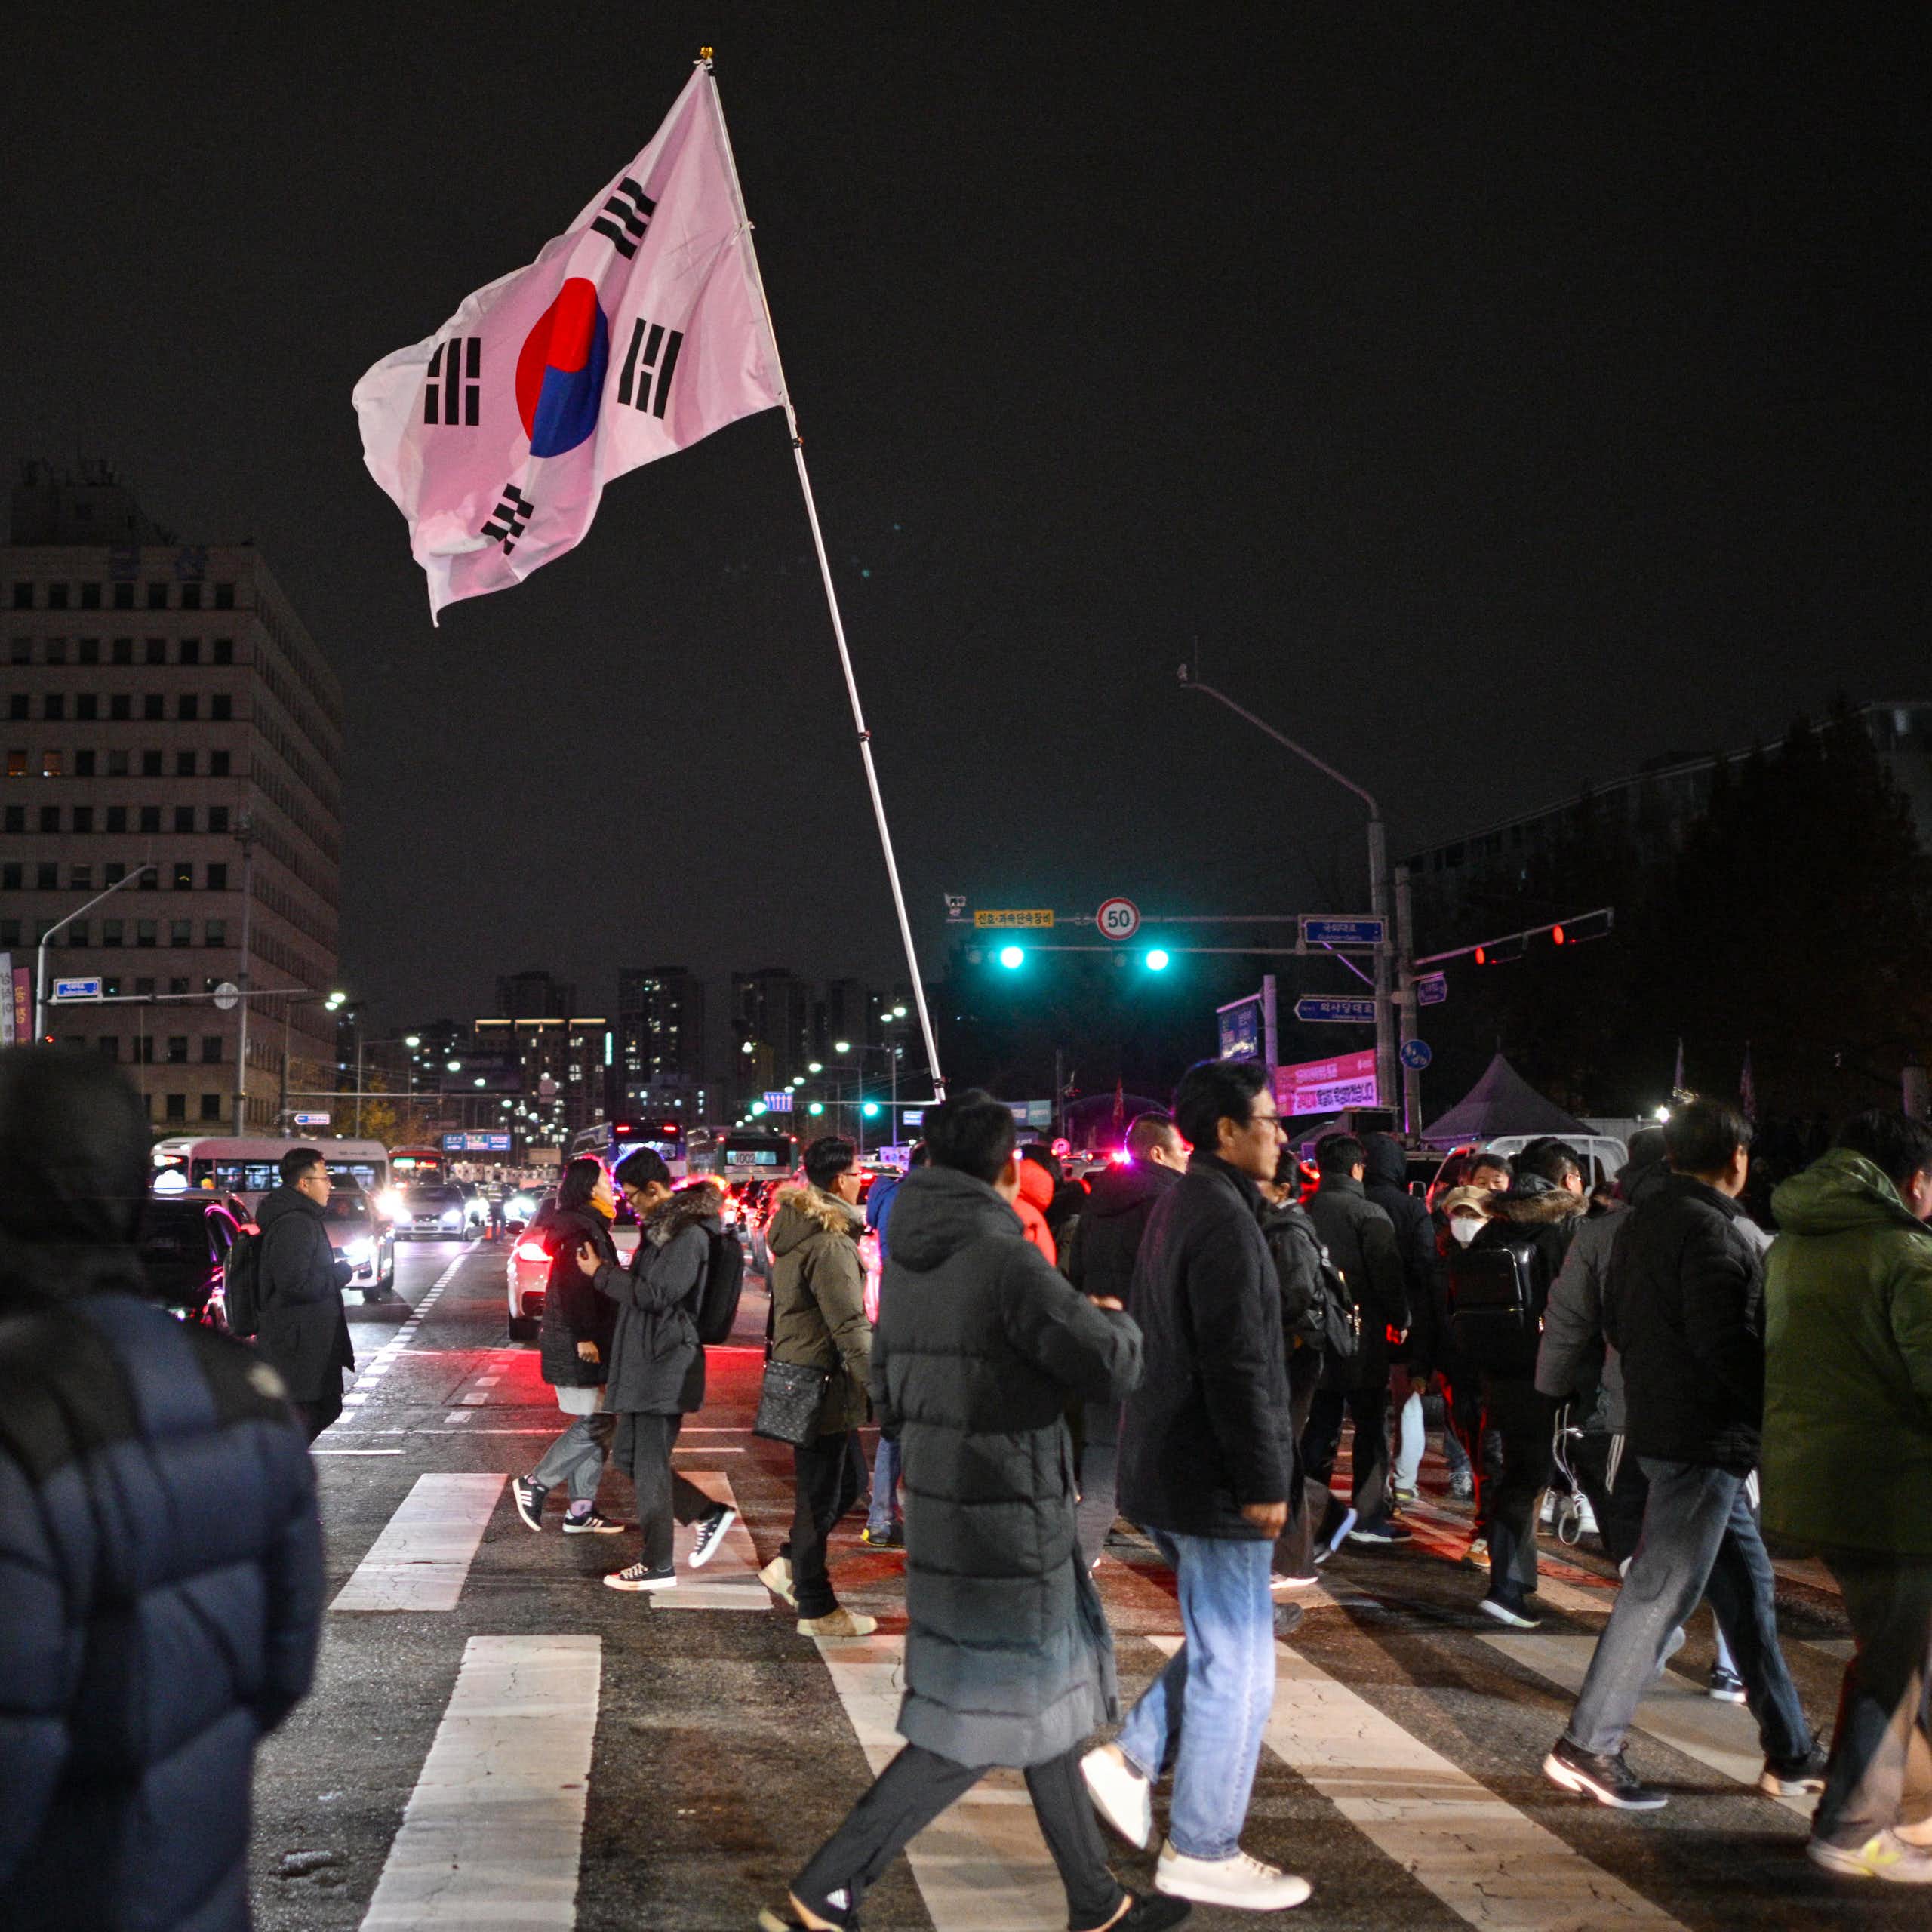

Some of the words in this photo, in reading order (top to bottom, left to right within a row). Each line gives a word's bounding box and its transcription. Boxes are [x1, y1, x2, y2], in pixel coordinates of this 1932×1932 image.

[1107, 909, 1131, 928] 50
[1320, 1002, 1373, 1014] 의사당대로
[736, 1153, 755, 1164] 1002
